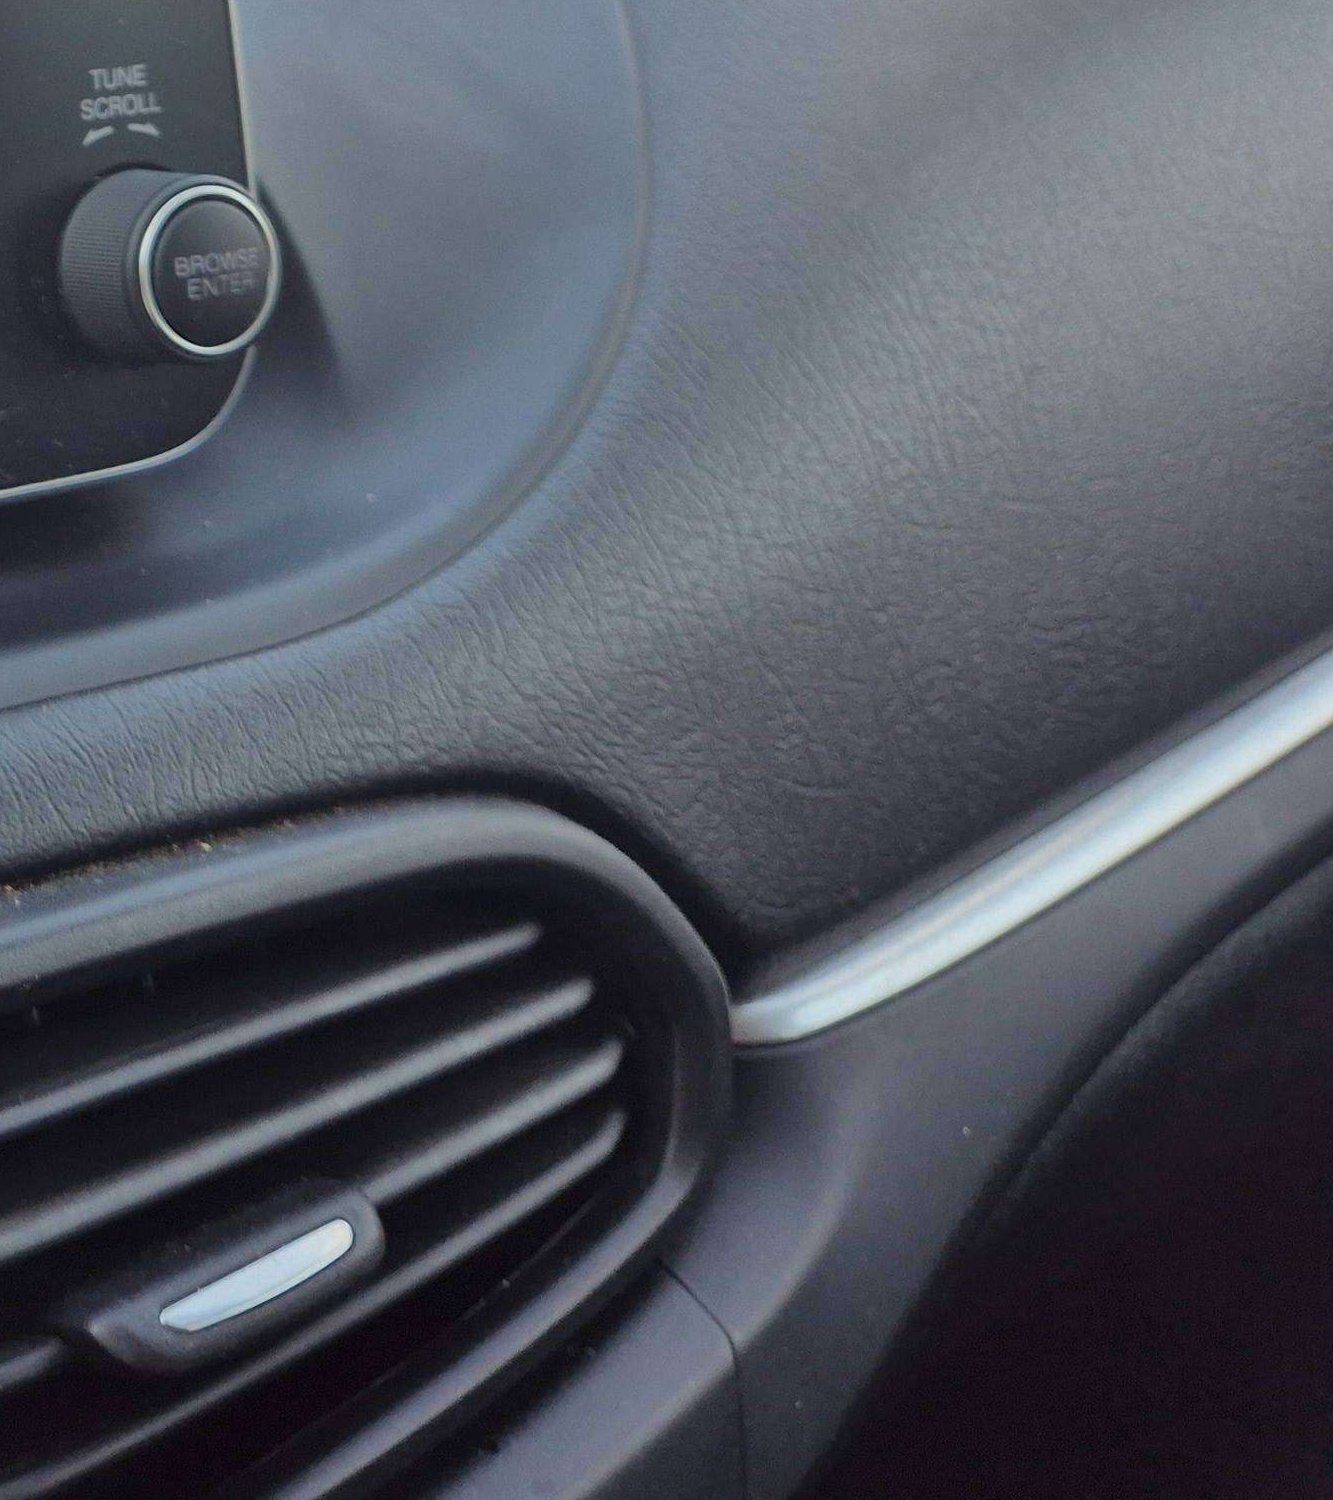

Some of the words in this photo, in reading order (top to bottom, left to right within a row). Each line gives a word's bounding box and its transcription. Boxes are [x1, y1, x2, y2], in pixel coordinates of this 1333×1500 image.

[89, 63, 148, 89] TUNE
[80, 91, 162, 123] SCROLL
[174, 247, 259, 279] BROWSE
[187, 272, 255, 301] ENTER
